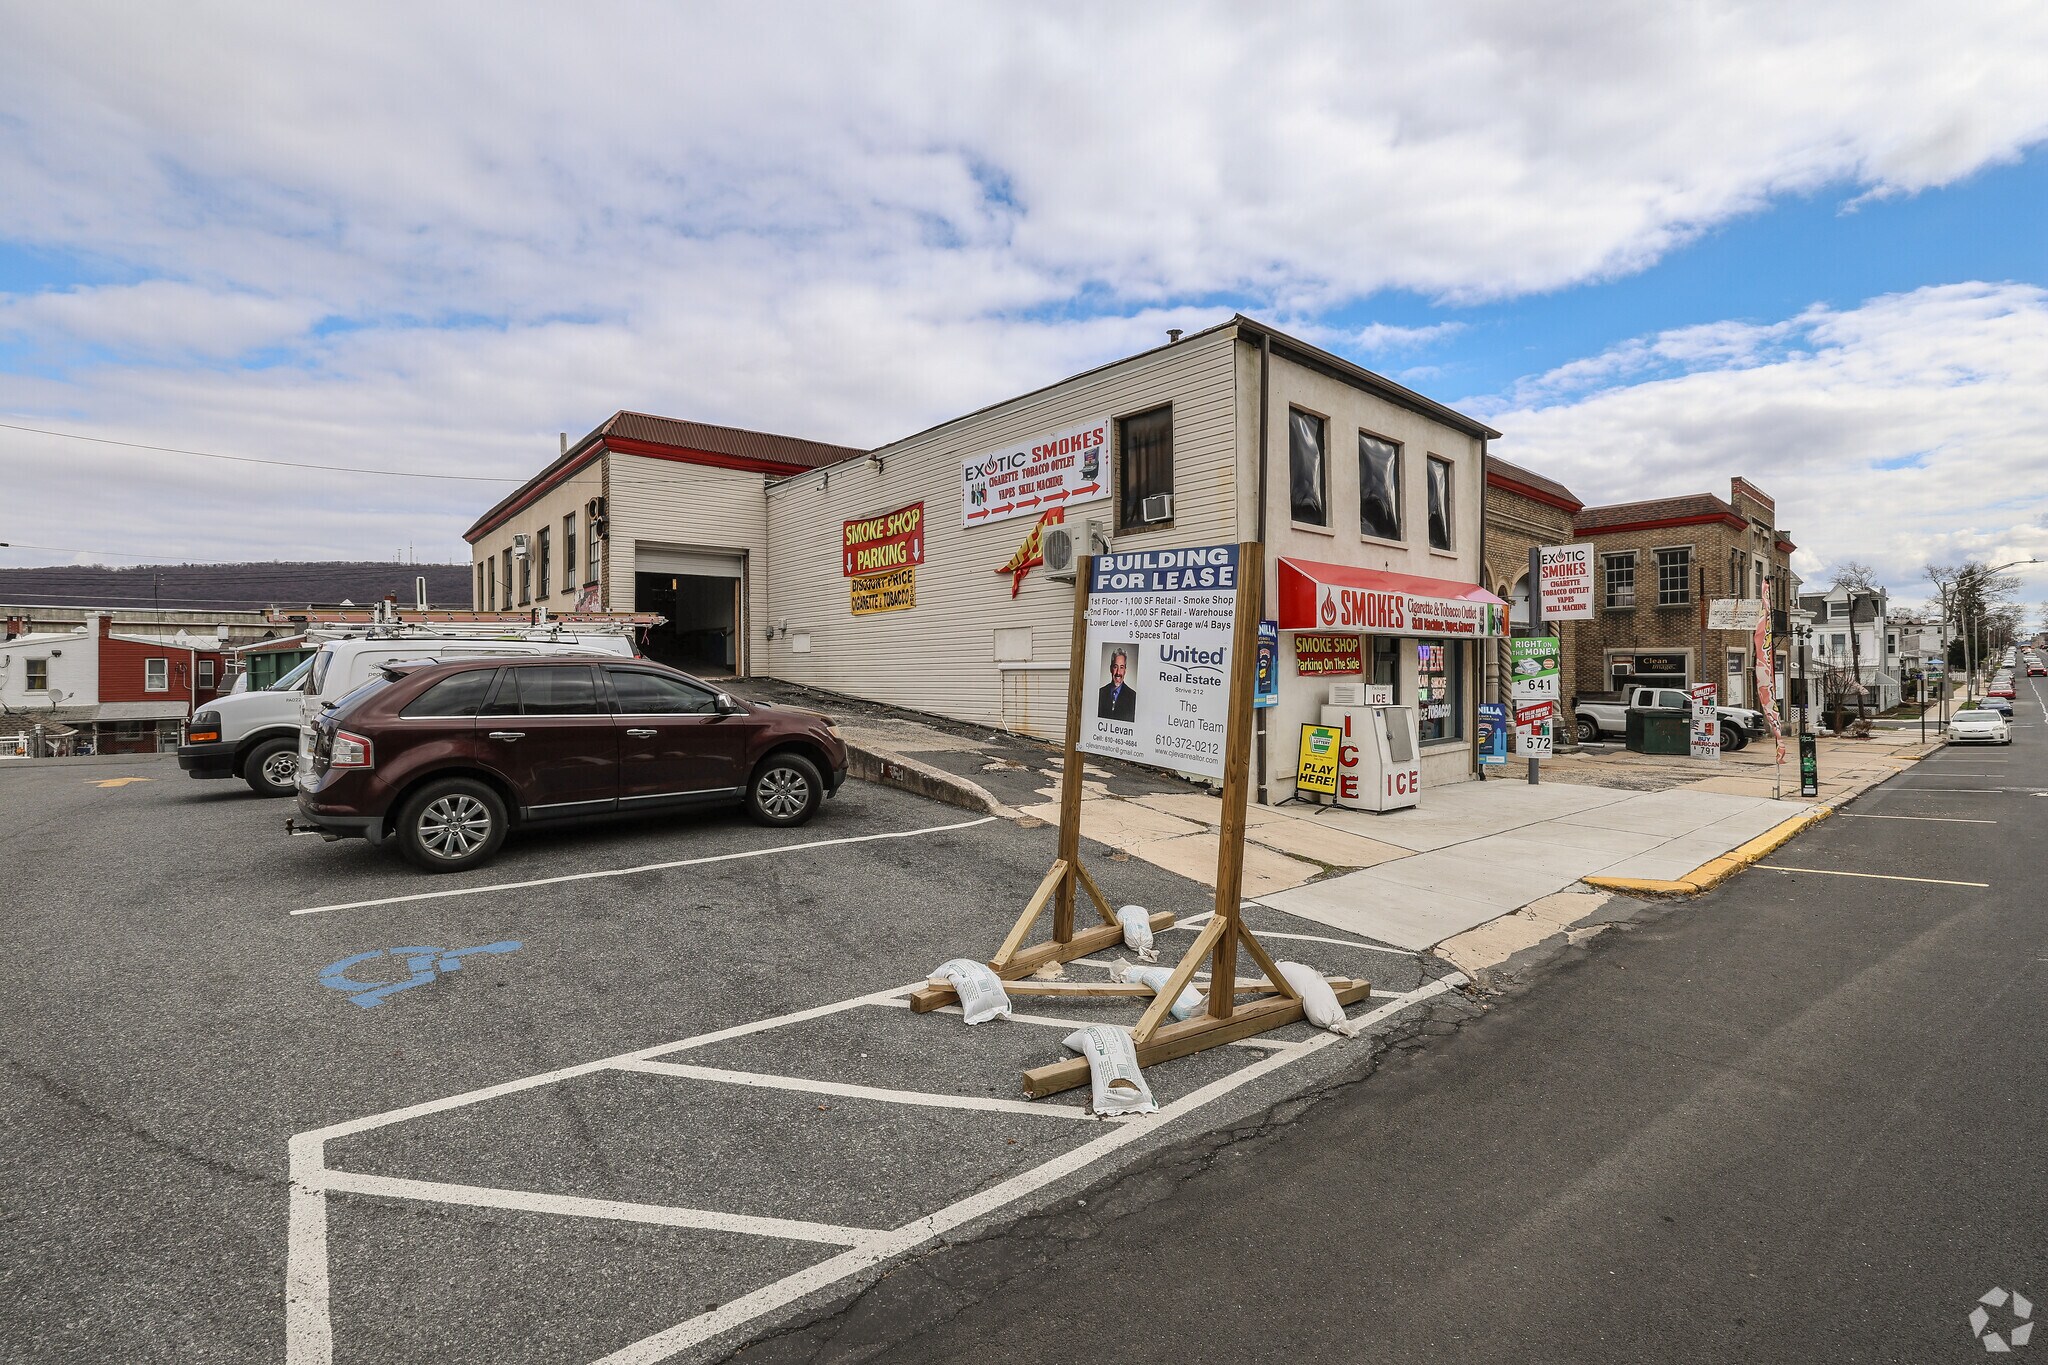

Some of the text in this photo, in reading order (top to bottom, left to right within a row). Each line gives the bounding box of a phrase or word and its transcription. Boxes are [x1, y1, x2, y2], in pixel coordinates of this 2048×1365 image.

[965, 427, 1104, 481] EXOTIC SMOKES
[989, 455, 1075, 488] CIGARETTE TOBACCO OUTLET
[998, 475, 1063, 500] VAPES SKILL MACHINE
[846, 508, 920, 546] SMOKE SHOP
[857, 541, 907, 571] PARKING
[1099, 548, 1228, 572] BUILDING
[1542, 549, 1585, 565] EXOTIC
[1097, 565, 1234, 590] FOR LEASE
[1542, 562, 1586, 578] SMOKES
[852, 569, 913, 593] DISCOUNT PRICE
[1550, 579, 1580, 587] CIGARETTE
[1542, 587, 1589, 596] TOBACCO OUTLET
[852, 593, 878, 612] CIGARETTE
[883, 588, 909, 608] TOBACCO
[1101, 597, 1118, 605] Floor
[1124, 597, 1142, 606] 1,100
[1143, 596, 1154, 605] SF
[1155, 596, 1176, 605] Retail
[1183, 596, 1211, 605] Smoke
[1212, 595, 1234, 606] Shop
[1562, 603, 1587, 611] MACHINE
[1102, 608, 1119, 616] Floor
[1126, 608, 1147, 617] 11,000
[1149, 608, 1159, 616] SF
[1161, 608, 1182, 616] Retail
[1188, 608, 1234, 617] Warehouse
[1341, 590, 1404, 629] SMOKES
[1408, 598, 1477, 619] Cigarette & Tobacco Outlet
[1089, 619, 1109, 627] Lower
[1110, 619, 1128, 627] Level
[1134, 620, 1152, 629] 6,000
[1154, 620, 1164, 628] SF
[1166, 620, 1193, 630] Garage
[1195, 620, 1209, 629] w/4
[1211, 620, 1232, 631] Bays
[1258, 624, 1276, 638] NILLA
[1412, 617, 1423, 630] Skill
[1129, 631, 1180, 641] 9 Spaces Total
[1296, 637, 1358, 653] SMOKE SHOP
[1525, 648, 1557, 656] MONEY
[1160, 644, 1224, 665] United
[1297, 657, 1360, 673] Parking On The Side
[1159, 672, 1221, 687] Real Estate
[1175, 687, 1192, 695] Strive
[1372, 694, 1386, 703] ICE
[1432, 688, 1445, 700] SHOP
[1179, 700, 1198, 713] The
[1428, 703, 1451, 719] TOBACCO
[1479, 706, 1502, 716] NILLA
[1097, 722, 1134, 737] CJ Levan
[1168, 715, 1224, 733] Levan Team
[1155, 734, 1219, 755] 610-372-0212
[1340, 711, 1359, 799] ICE
[1304, 763, 1334, 775] PLAY
[1299, 773, 1335, 787] HERE!
[1387, 771, 1418, 797] ICE
